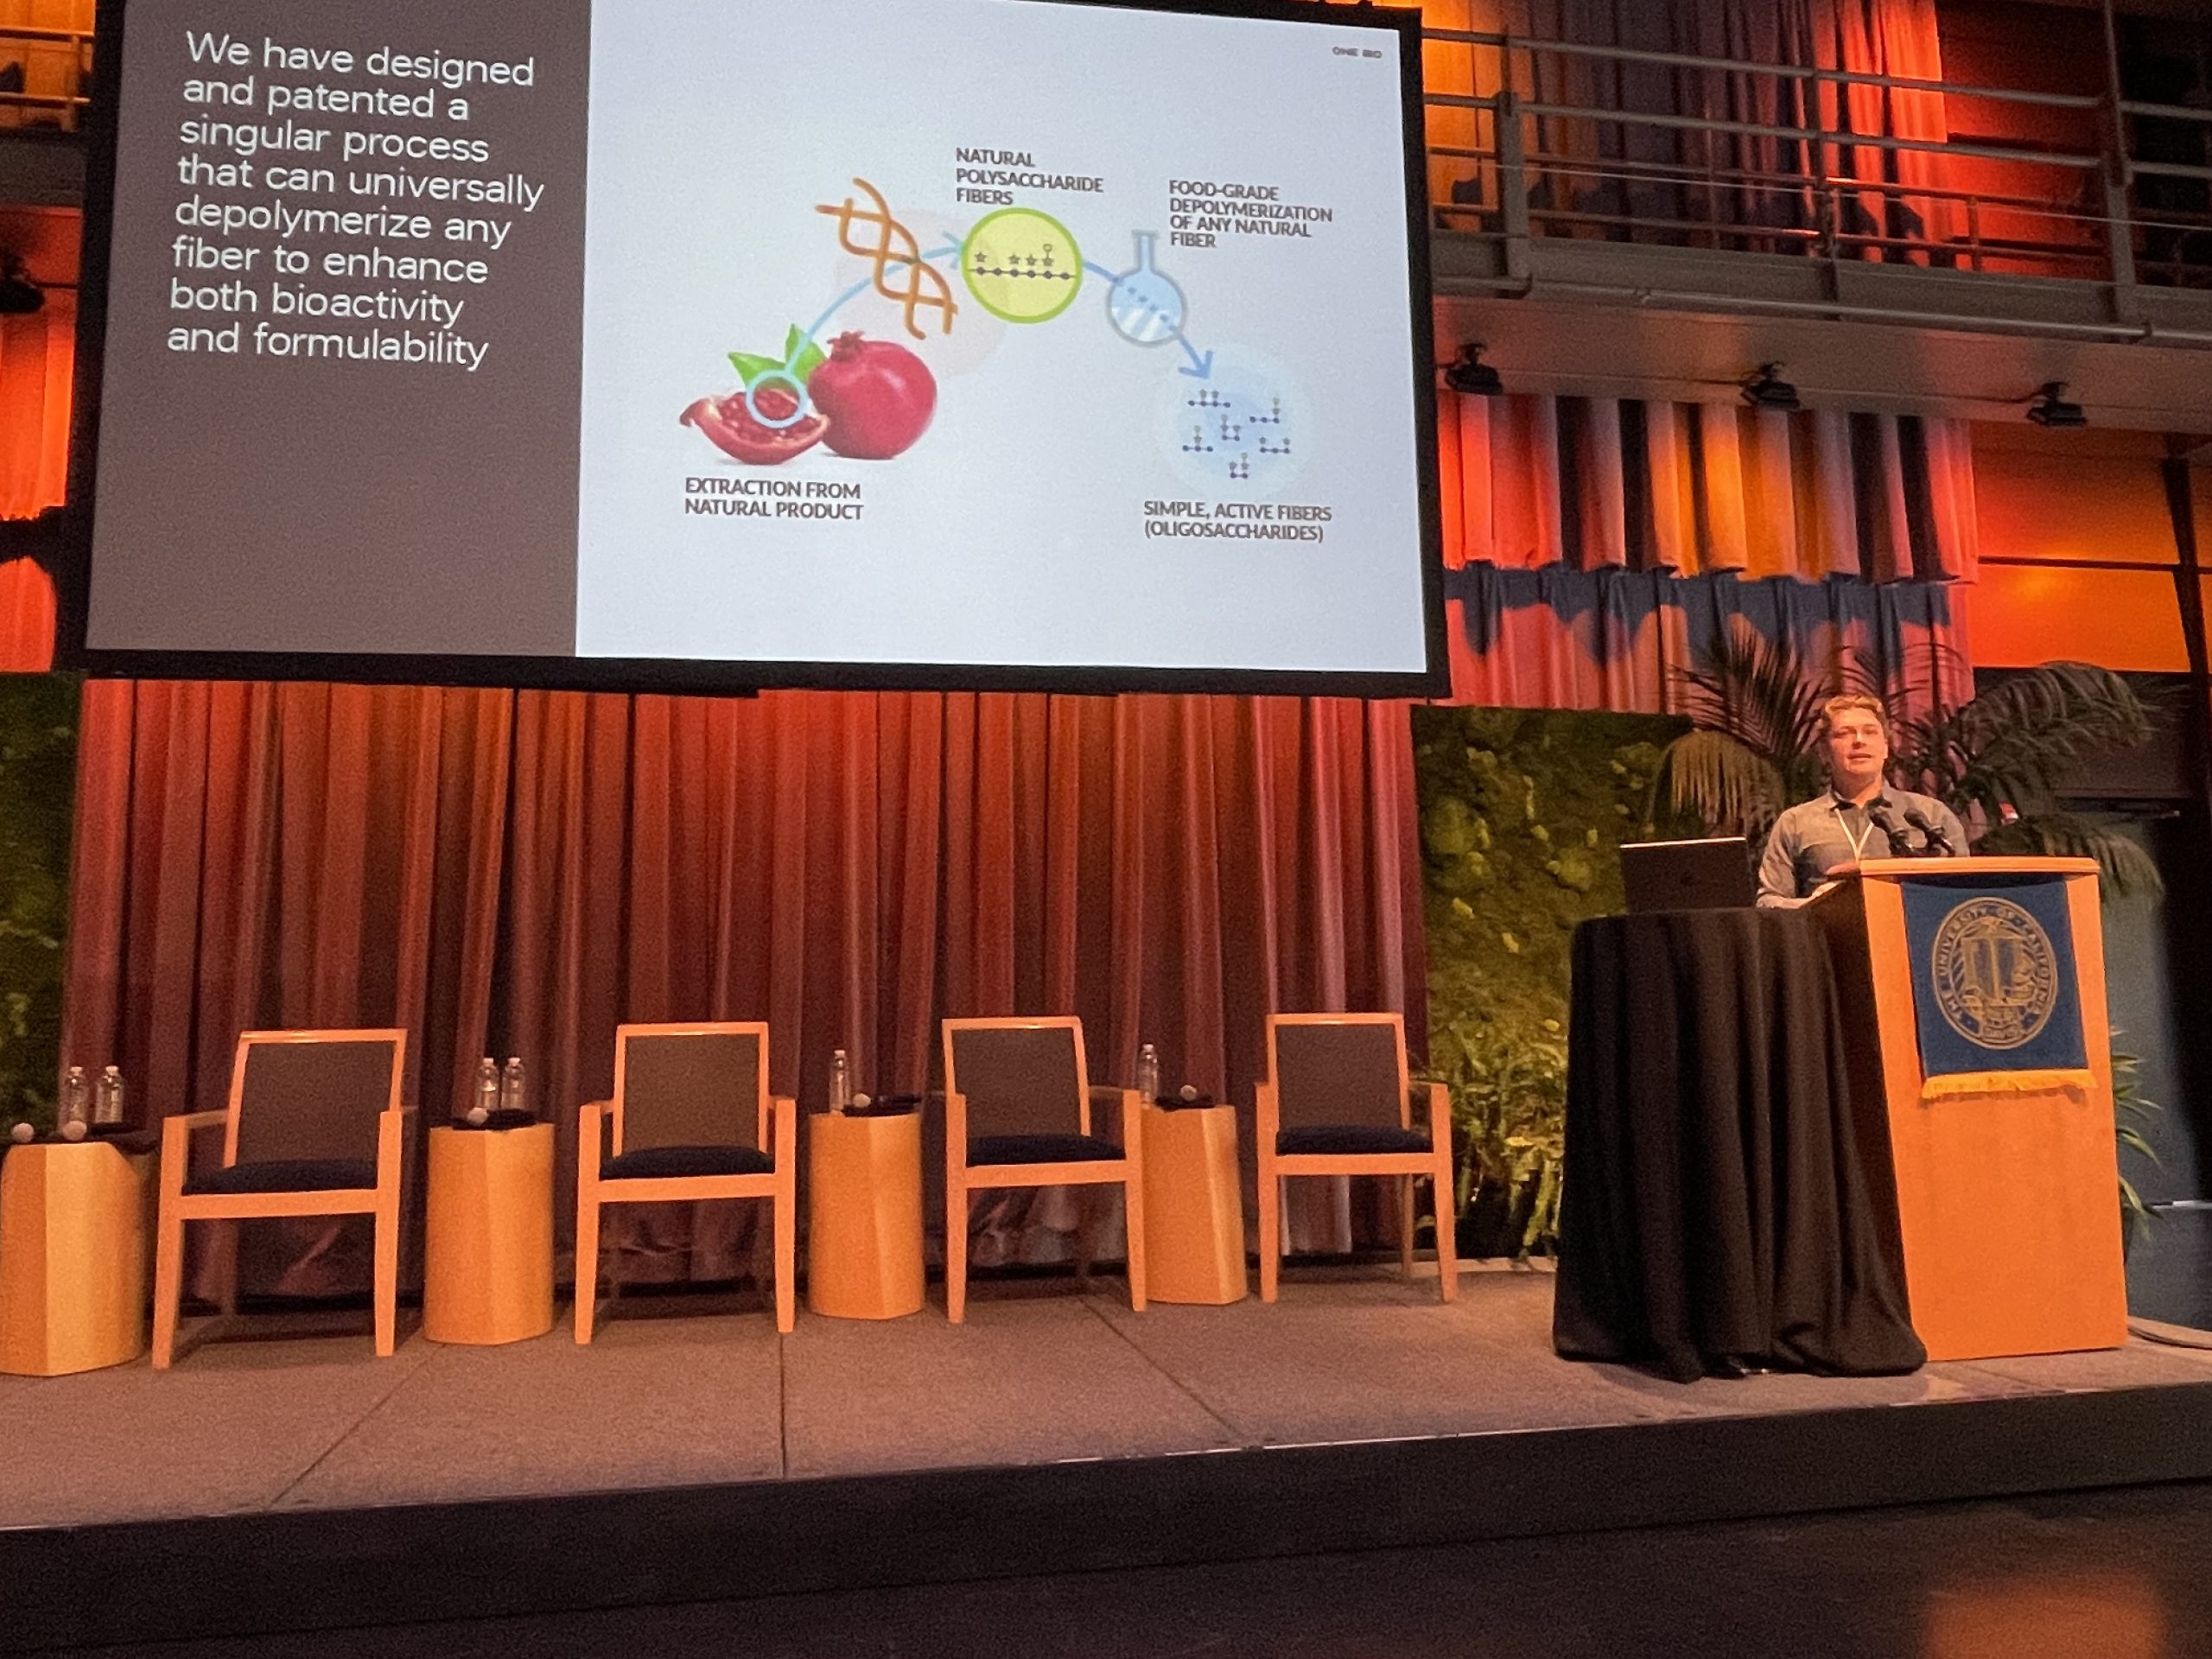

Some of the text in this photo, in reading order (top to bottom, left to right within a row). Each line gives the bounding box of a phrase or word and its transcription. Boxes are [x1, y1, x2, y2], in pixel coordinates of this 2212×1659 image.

[186, 30, 534, 89] We have designed
[183, 75, 469, 120] and patented a
[180, 113, 489, 162] singular process
[957, 148, 1036, 168] NATURAL
[177, 153, 544, 212] that can universally
[957, 168, 1104, 193] POLYSACCHARIDE
[1169, 180, 1279, 201] FOOD-GRADE
[957, 188, 1014, 206] FIBERS
[175, 194, 512, 250] depolymerize any
[1169, 198, 1333, 223] DEPOLYMERIZATION
[1170, 215, 1313, 238] OF ANY NATURAL
[1171, 232, 1217, 248] FIBER
[172, 234, 488, 283] fiber to enhance
[170, 277, 464, 329] both bioactivity
[168, 321, 489, 372] and formulability
[685, 477, 861, 499] EXTRACTION FROM
[685, 498, 864, 520] NATURAL PRODUCT
[1144, 500, 1332, 522] SIMPLE, ACTIVE FIBERS
[1145, 520, 1324, 543] (OLIGOSACCHARIDES)
